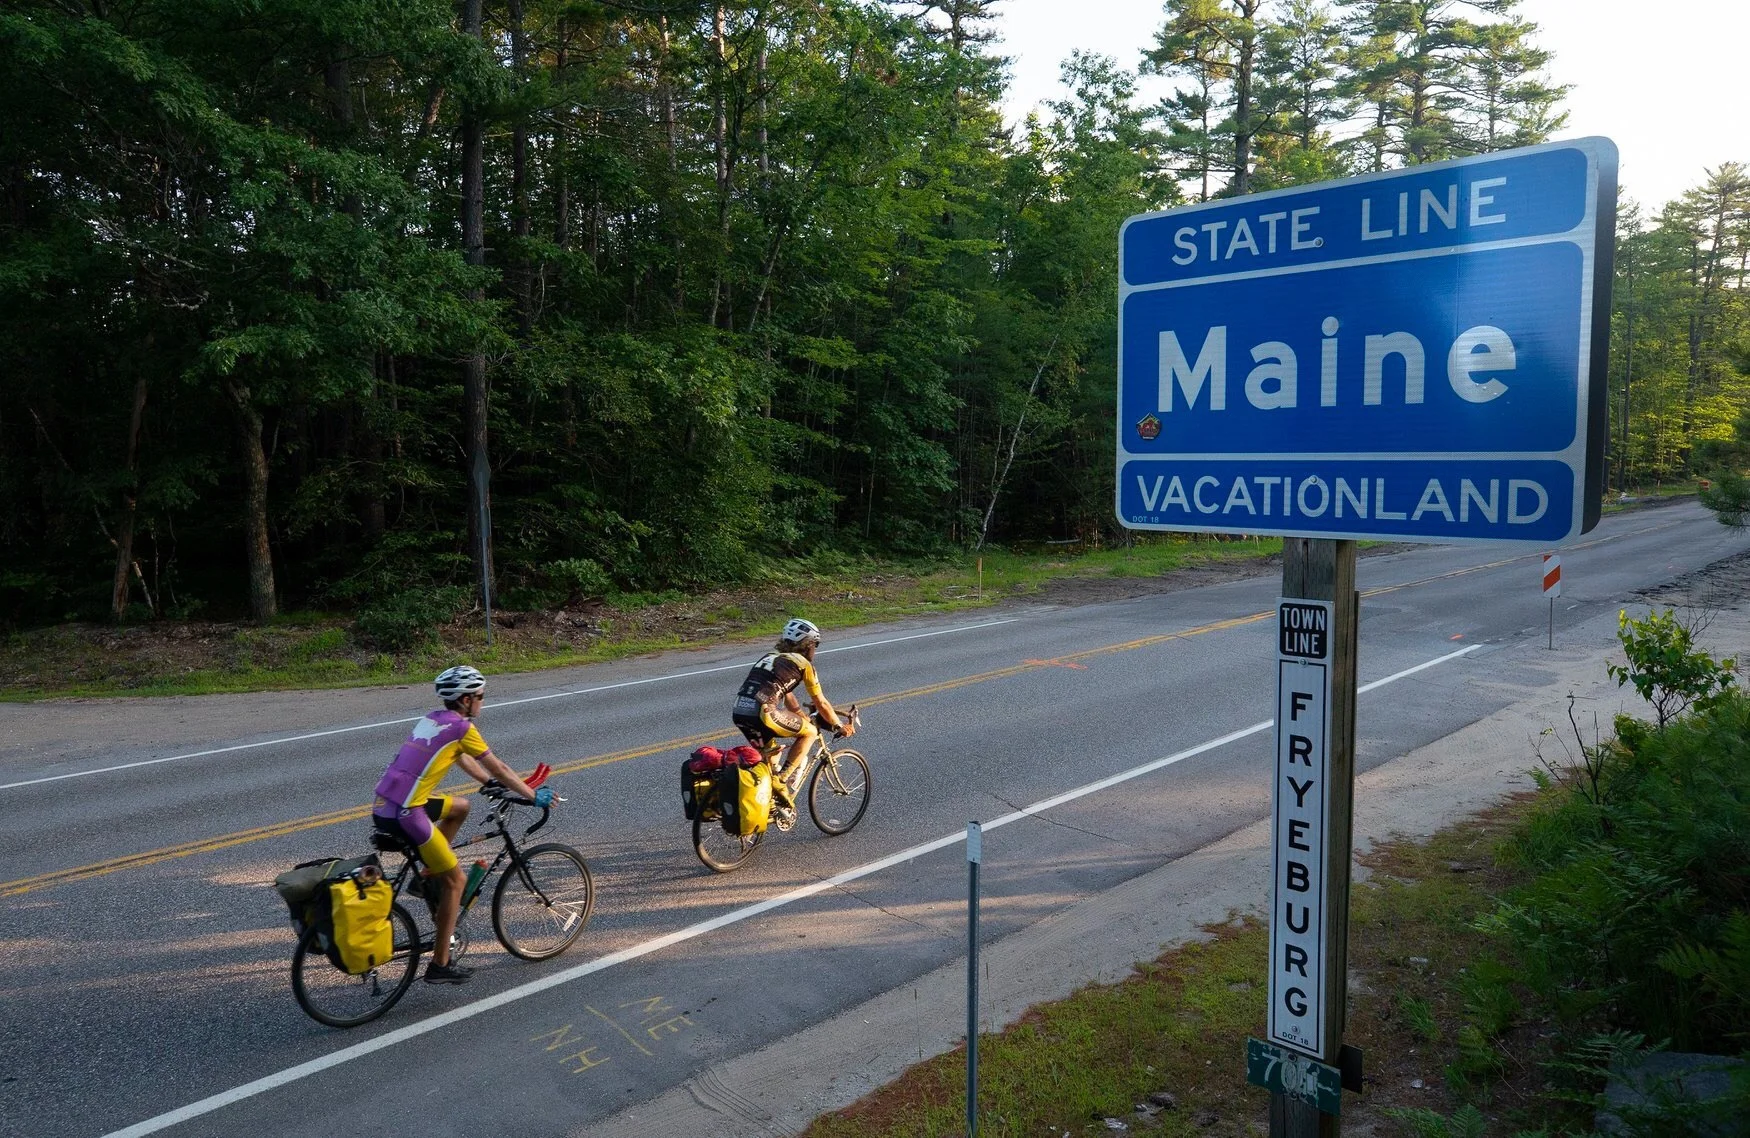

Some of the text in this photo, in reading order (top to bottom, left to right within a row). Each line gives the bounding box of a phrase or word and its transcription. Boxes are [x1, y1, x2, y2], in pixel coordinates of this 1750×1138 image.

[1171, 177, 1507, 265] STATE LINE
[1158, 316, 1516, 412] Maine
[1137, 475, 1549, 525] VACATIONLAND
[1282, 607, 1326, 632] TOWN
[1285, 631, 1320, 655] LINE
[1284, 692, 1314, 1017] FRYEBURG
[619, 996, 695, 1041] ME
[1282, 1032, 1297, 1040] DOT
[529, 1024, 611, 1074] NH
